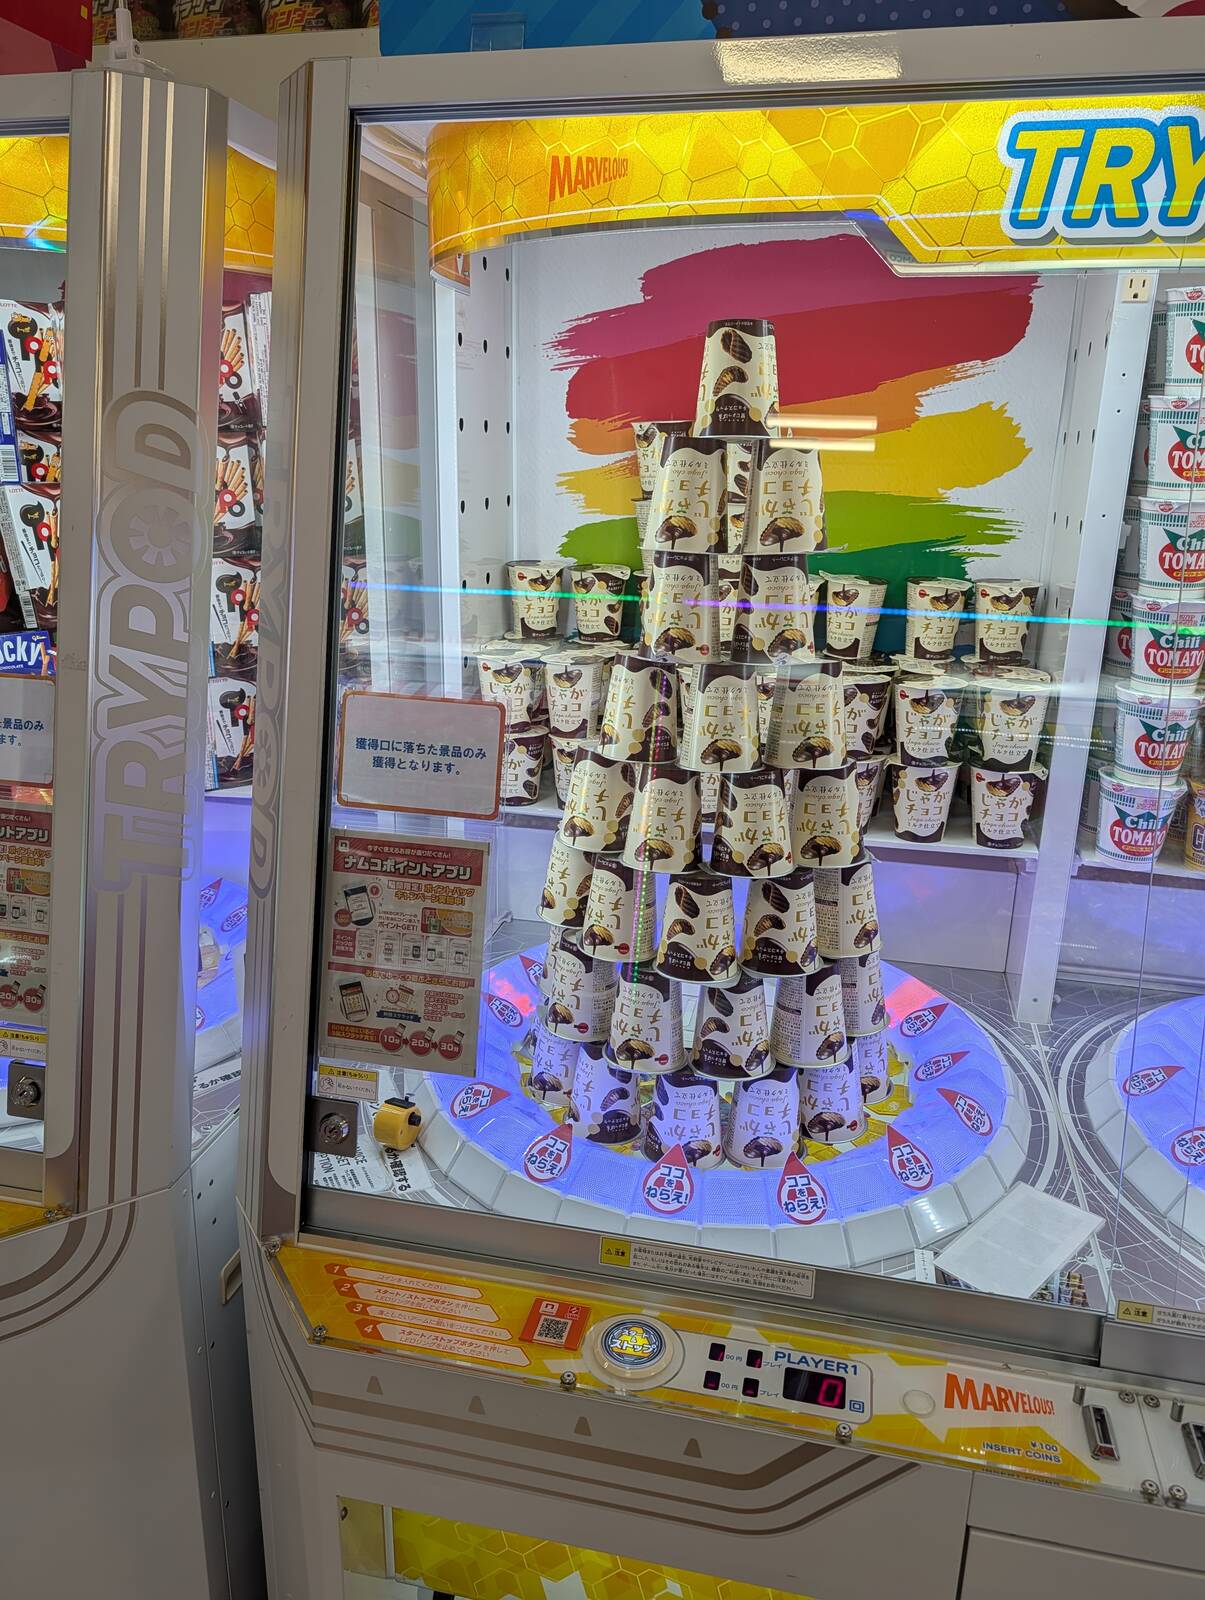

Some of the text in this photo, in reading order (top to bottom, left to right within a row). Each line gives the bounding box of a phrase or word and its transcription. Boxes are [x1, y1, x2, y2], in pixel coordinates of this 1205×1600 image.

[548, 154, 629, 201] MARVELOUS!
[662, 479, 711, 497] チョコ
[764, 478, 812, 496] チョコ
[755, 500, 813, 517] じゃが
[524, 603, 555, 614] チョコ
[754, 612, 808, 631] じゃが
[922, 623, 955, 634] チョコ
[984, 623, 1020, 635] チョコ
[1160, 635, 1200, 648] Chili
[0, 636, 43, 665] cky
[1148, 649, 1204, 666] TOMATO
[489, 682, 529, 696] じゃが
[551, 701, 581, 712] チョコ
[795, 701, 841, 717] チョコ
[0, 718, 44, 731] 景品のみ
[786, 719, 841, 735] じゃが
[905, 711, 950, 726] じゃが
[991, 713, 1037, 729] じゃが
[904, 727, 942, 740] チョコ
[1152, 729, 1188, 741] Chili
[355, 736, 487, 760] 獲得口に落ちた景品のみ
[372, 754, 462, 776] 獲得となります。
[906, 790, 950, 804] じゃが
[982, 793, 1027, 810] じゃが
[743, 807, 786, 823] チョコ
[803, 803, 850, 818] チョコ
[905, 803, 943, 816] チョコ
[980, 809, 1018, 822] チョコ
[796, 819, 850, 836] じゃが
[1125, 816, 1163, 829] Chili
[734, 826, 786, 845] じゃが
[1113, 826, 1165, 846] TOMATO
[344, 855, 472, 880] ナムコポイントアプリ
[620, 1002, 663, 1025] チョコ
[613, 1018, 660, 1042] じゃが
[807, 1080, 850, 1095] チョコ
[673, 1104, 716, 1121] チョコ
[747, 1103, 792, 1120] チョコ
[664, 1122, 716, 1141] じゃが
[739, 1120, 792, 1136] じゃが
[545, 1136, 568, 1154] ココ
[893, 1143, 915, 1163] ココ
[527, 1152, 562, 1177] ねらえ!
[660, 1164, 685, 1179] ココ
[786, 1174, 812, 1189] ココ
[898, 1164, 933, 1183] ねらえ!
[665, 1178, 675, 1188] を
[645, 1185, 690, 1205] ねらえ!
[796, 1188, 807, 1198] を
[783, 1195, 827, 1213] ねらえ!
[332, 1265, 341, 1274] 1
[342, 1282, 351, 1292] 2
[376, 1273, 448, 1291] コインを入れてください
[374, 1287, 453, 1308] スタート/ストップボタン
[353, 1302, 364, 1312] 3
[364, 1323, 373, 1334] 4
[399, 1328, 480, 1350] スタート/ストップボタン
[610, 1339, 657, 1353] ストップ
[774, 1351, 859, 1375] PLAYER1
[759, 1390, 780, 1398] プレイ
[817, 1377, 844, 1408] 0
[943, 1373, 1056, 1416] MARVELOUS!
[982, 1441, 1062, 1464] INSERT COINS
